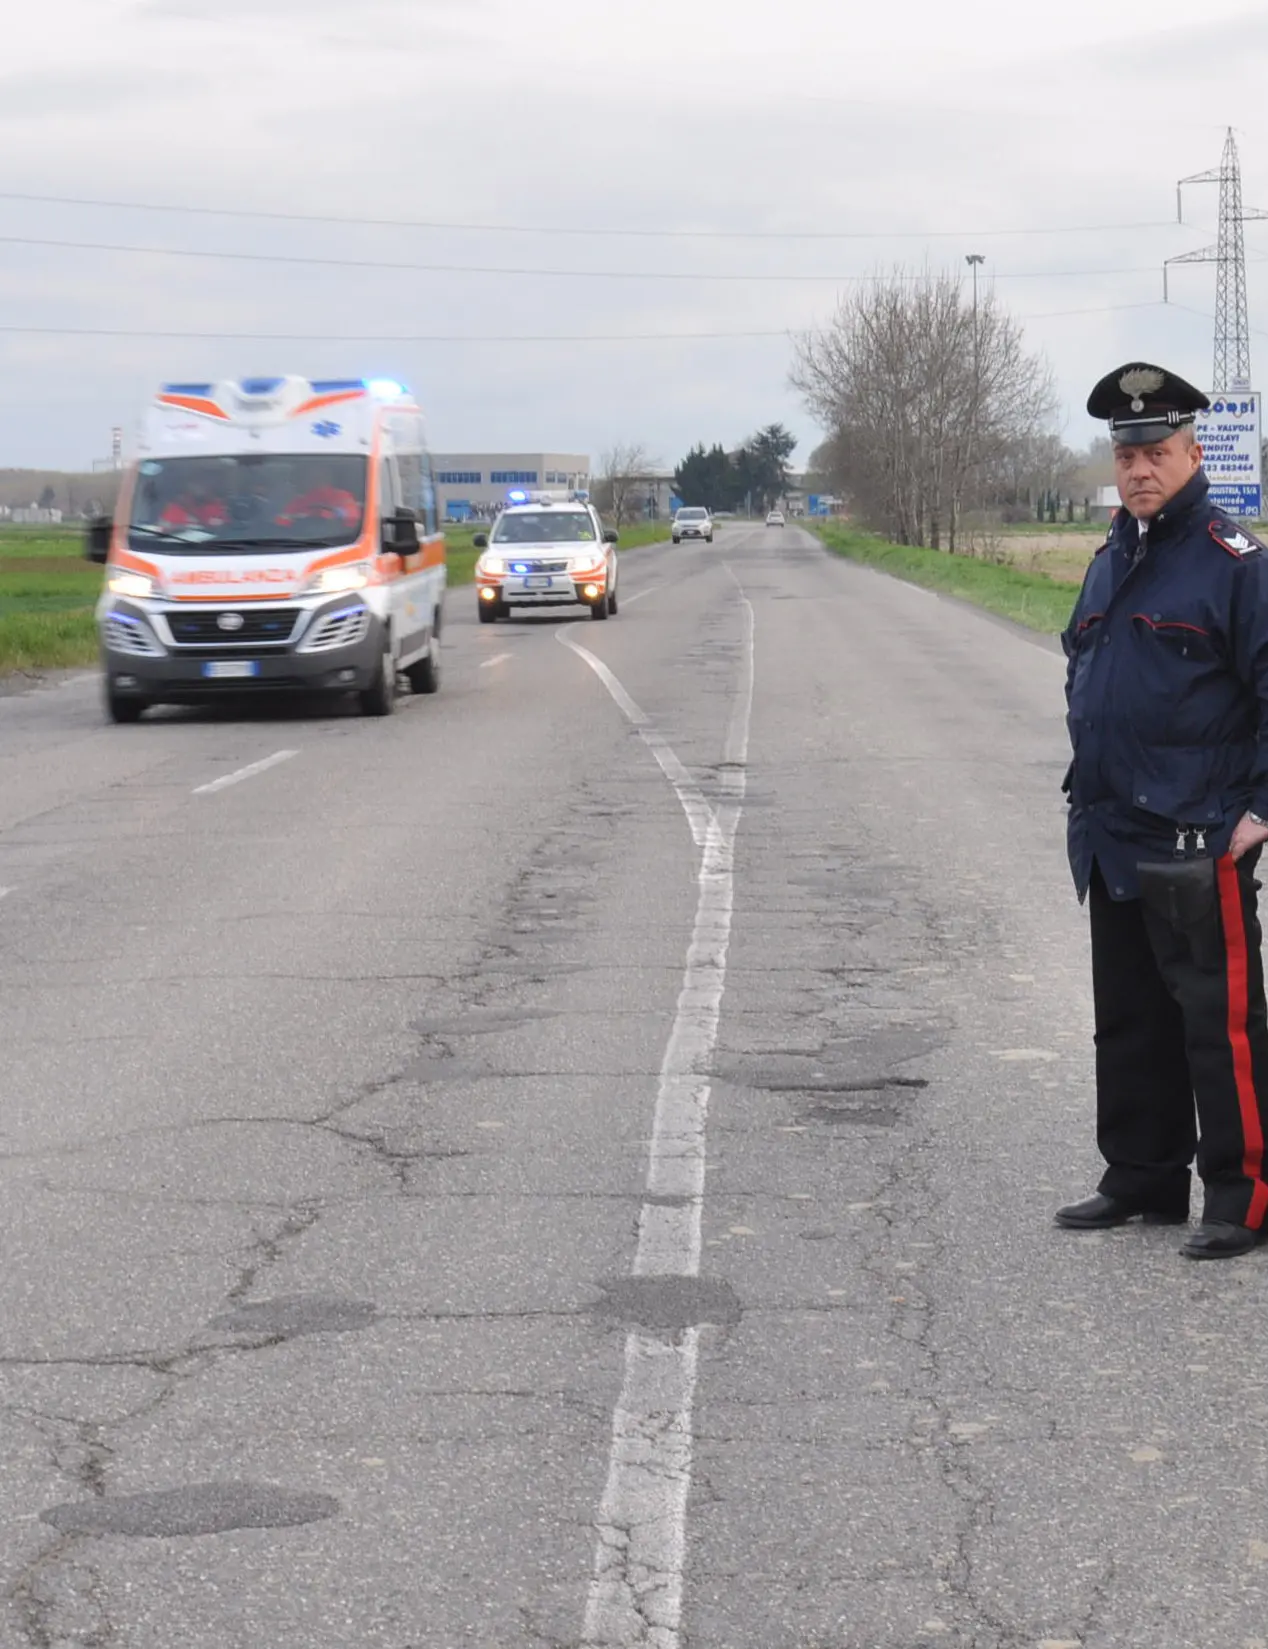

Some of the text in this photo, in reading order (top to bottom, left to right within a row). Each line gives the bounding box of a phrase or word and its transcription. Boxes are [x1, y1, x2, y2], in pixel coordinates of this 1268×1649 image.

[1217, 424, 1254, 432] VALVOLE
[1197, 434, 1240, 442] UTOCLAVI
[1203, 444, 1235, 452] ENDITA
[1208, 486, 1241, 496] NDUSTRIA,
